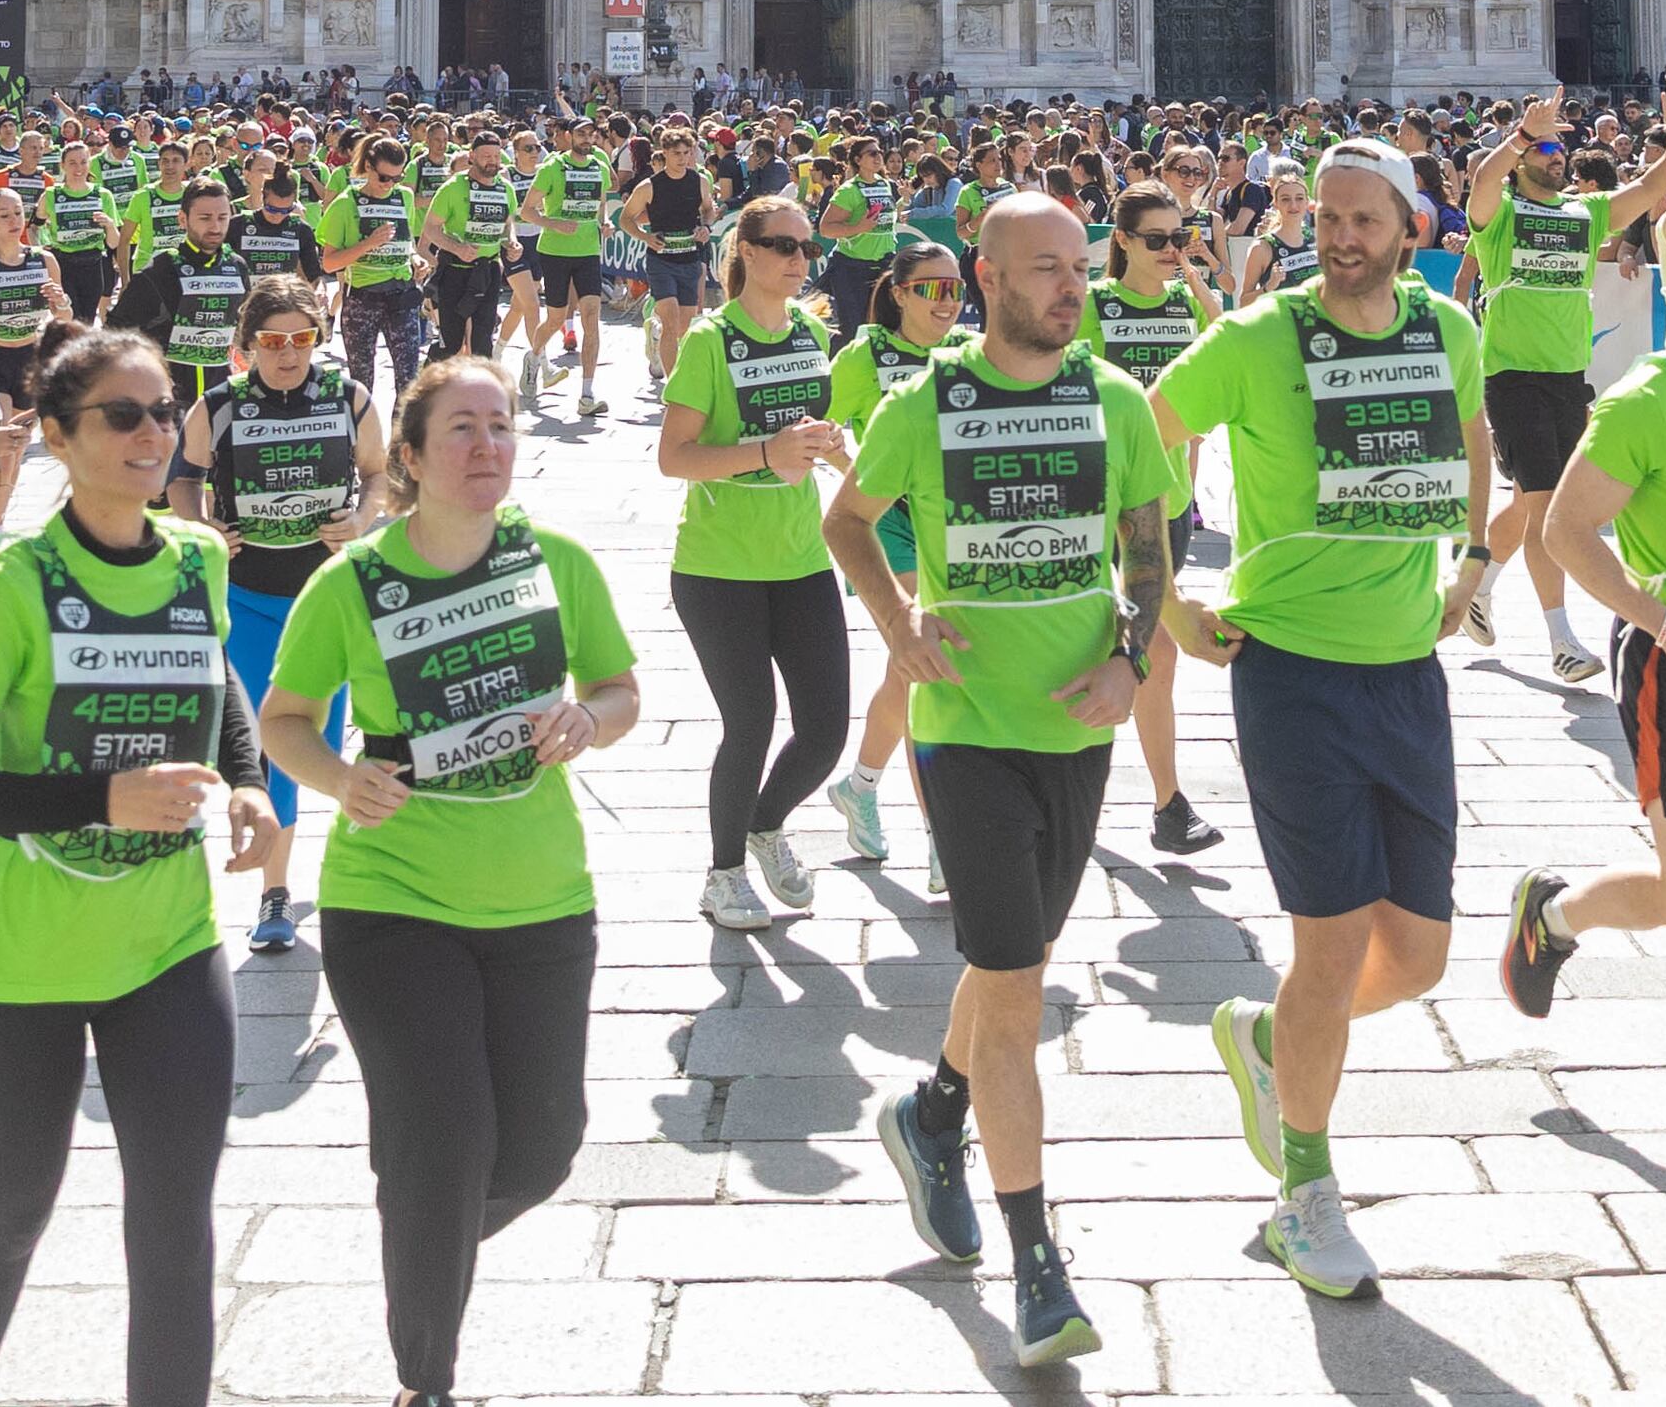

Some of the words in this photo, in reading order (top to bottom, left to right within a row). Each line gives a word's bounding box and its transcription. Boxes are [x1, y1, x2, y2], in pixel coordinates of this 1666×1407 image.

[474, 205, 503, 214] STRA
[1523, 217, 1582, 233] 20996
[1533, 233, 1567, 244] STRA
[256, 263, 281, 271] STRA
[1521, 256, 1557, 269] BANCO
[1559, 258, 1579, 270] BPM
[204, 280, 239, 289] HYUNDAI
[1, 299, 31, 309] STRA
[196, 297, 229, 310] 7103
[195, 311, 225, 321] STRA
[179, 334, 214, 345] BANCO
[1134, 324, 1191, 337] HYUNDAI
[1403, 332, 1435, 345] HOKA
[764, 357, 823, 376] HYUNDAI
[1359, 364, 1441, 384] HYUNDAI
[1051, 386, 1090, 396] HOKA
[765, 405, 806, 424] STRA
[1345, 399, 1432, 428] 3369
[273, 422, 337, 435] HYUNDAI
[997, 416, 1091, 434] HYUNDAI
[1356, 430, 1420, 453] STRA
[259, 443, 324, 465] 3844
[265, 466, 314, 481] STRA
[973, 450, 1079, 480] 26716
[989, 484, 1058, 505] STRA
[1336, 482, 1411, 500] BANCO
[1415, 479, 1453, 497] BPM
[252, 504, 303, 516] BANCO
[305, 498, 332, 512] BPM
[967, 539, 1044, 559] BANCO
[1050, 535, 1088, 556] BPM
[489, 548, 532, 570] HOKA
[437, 583, 540, 626] HYUNDAI
[169, 606, 207, 623] HOKA
[114, 650, 210, 668] HYUNDAI
[419, 623, 536, 680] 42125
[444, 665, 520, 706] STRA
[73, 693, 201, 723] 42694
[93, 733, 166, 756] STRA
[435, 730, 515, 771] BANCO
